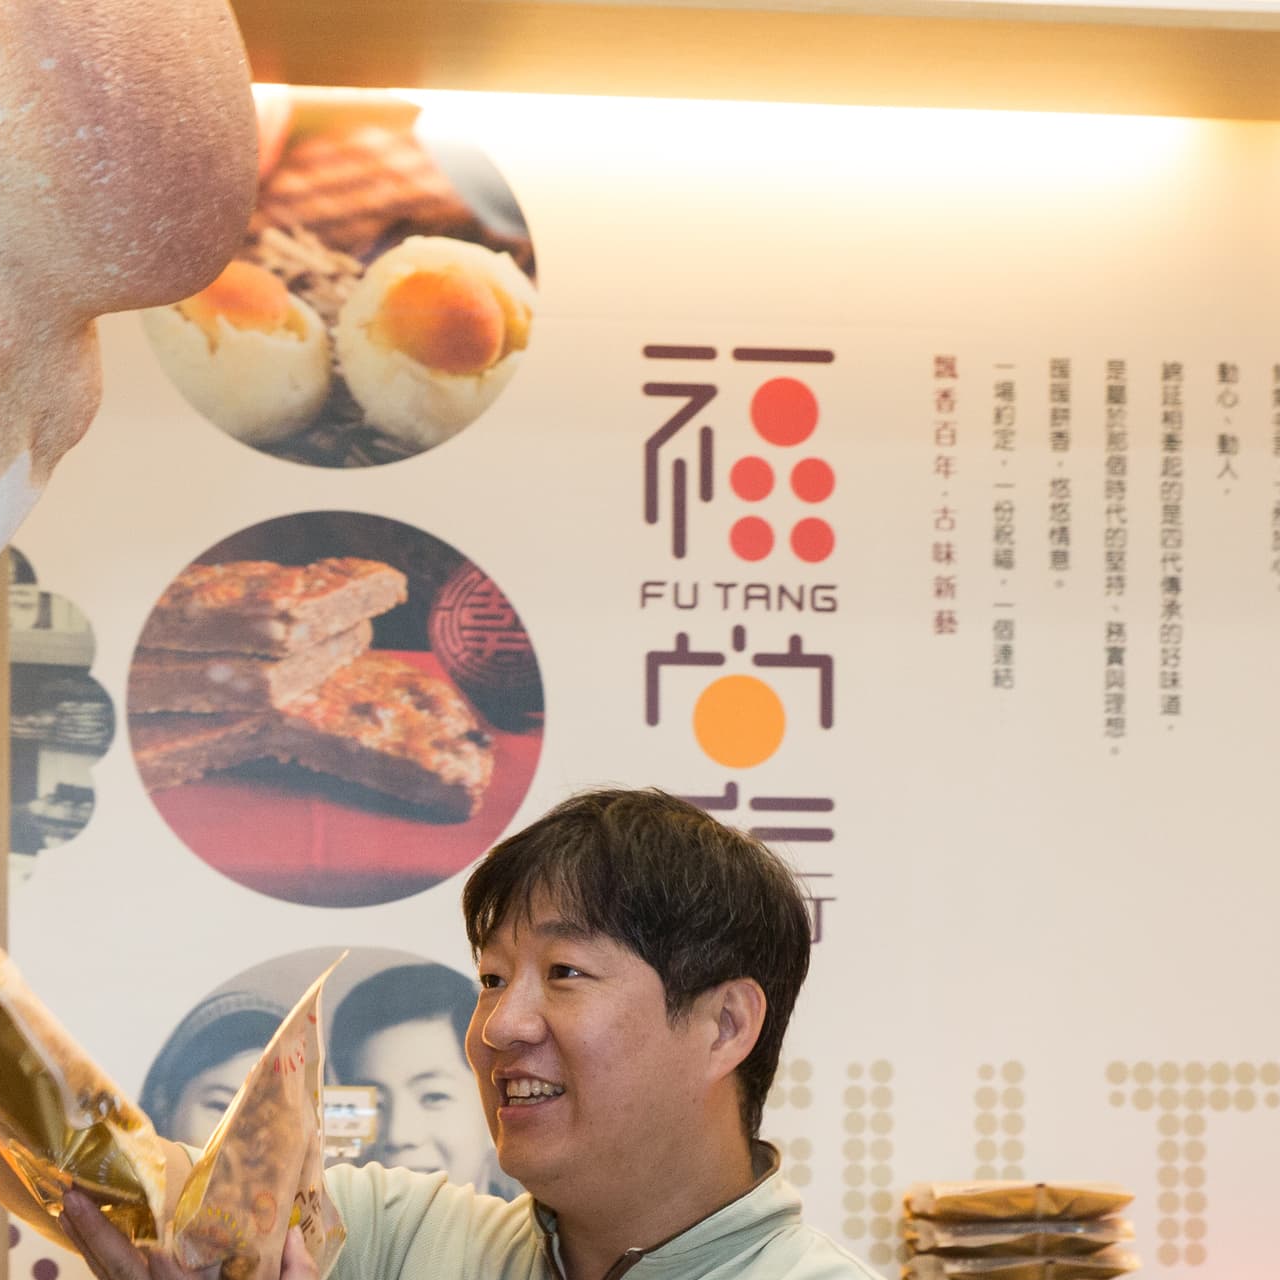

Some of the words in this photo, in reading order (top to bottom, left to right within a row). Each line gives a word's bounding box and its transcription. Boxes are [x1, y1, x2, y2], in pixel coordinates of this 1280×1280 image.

[641, 344, 836, 564] 福
[640, 580, 699, 610] FU
[713, 583, 838, 613] TANG
